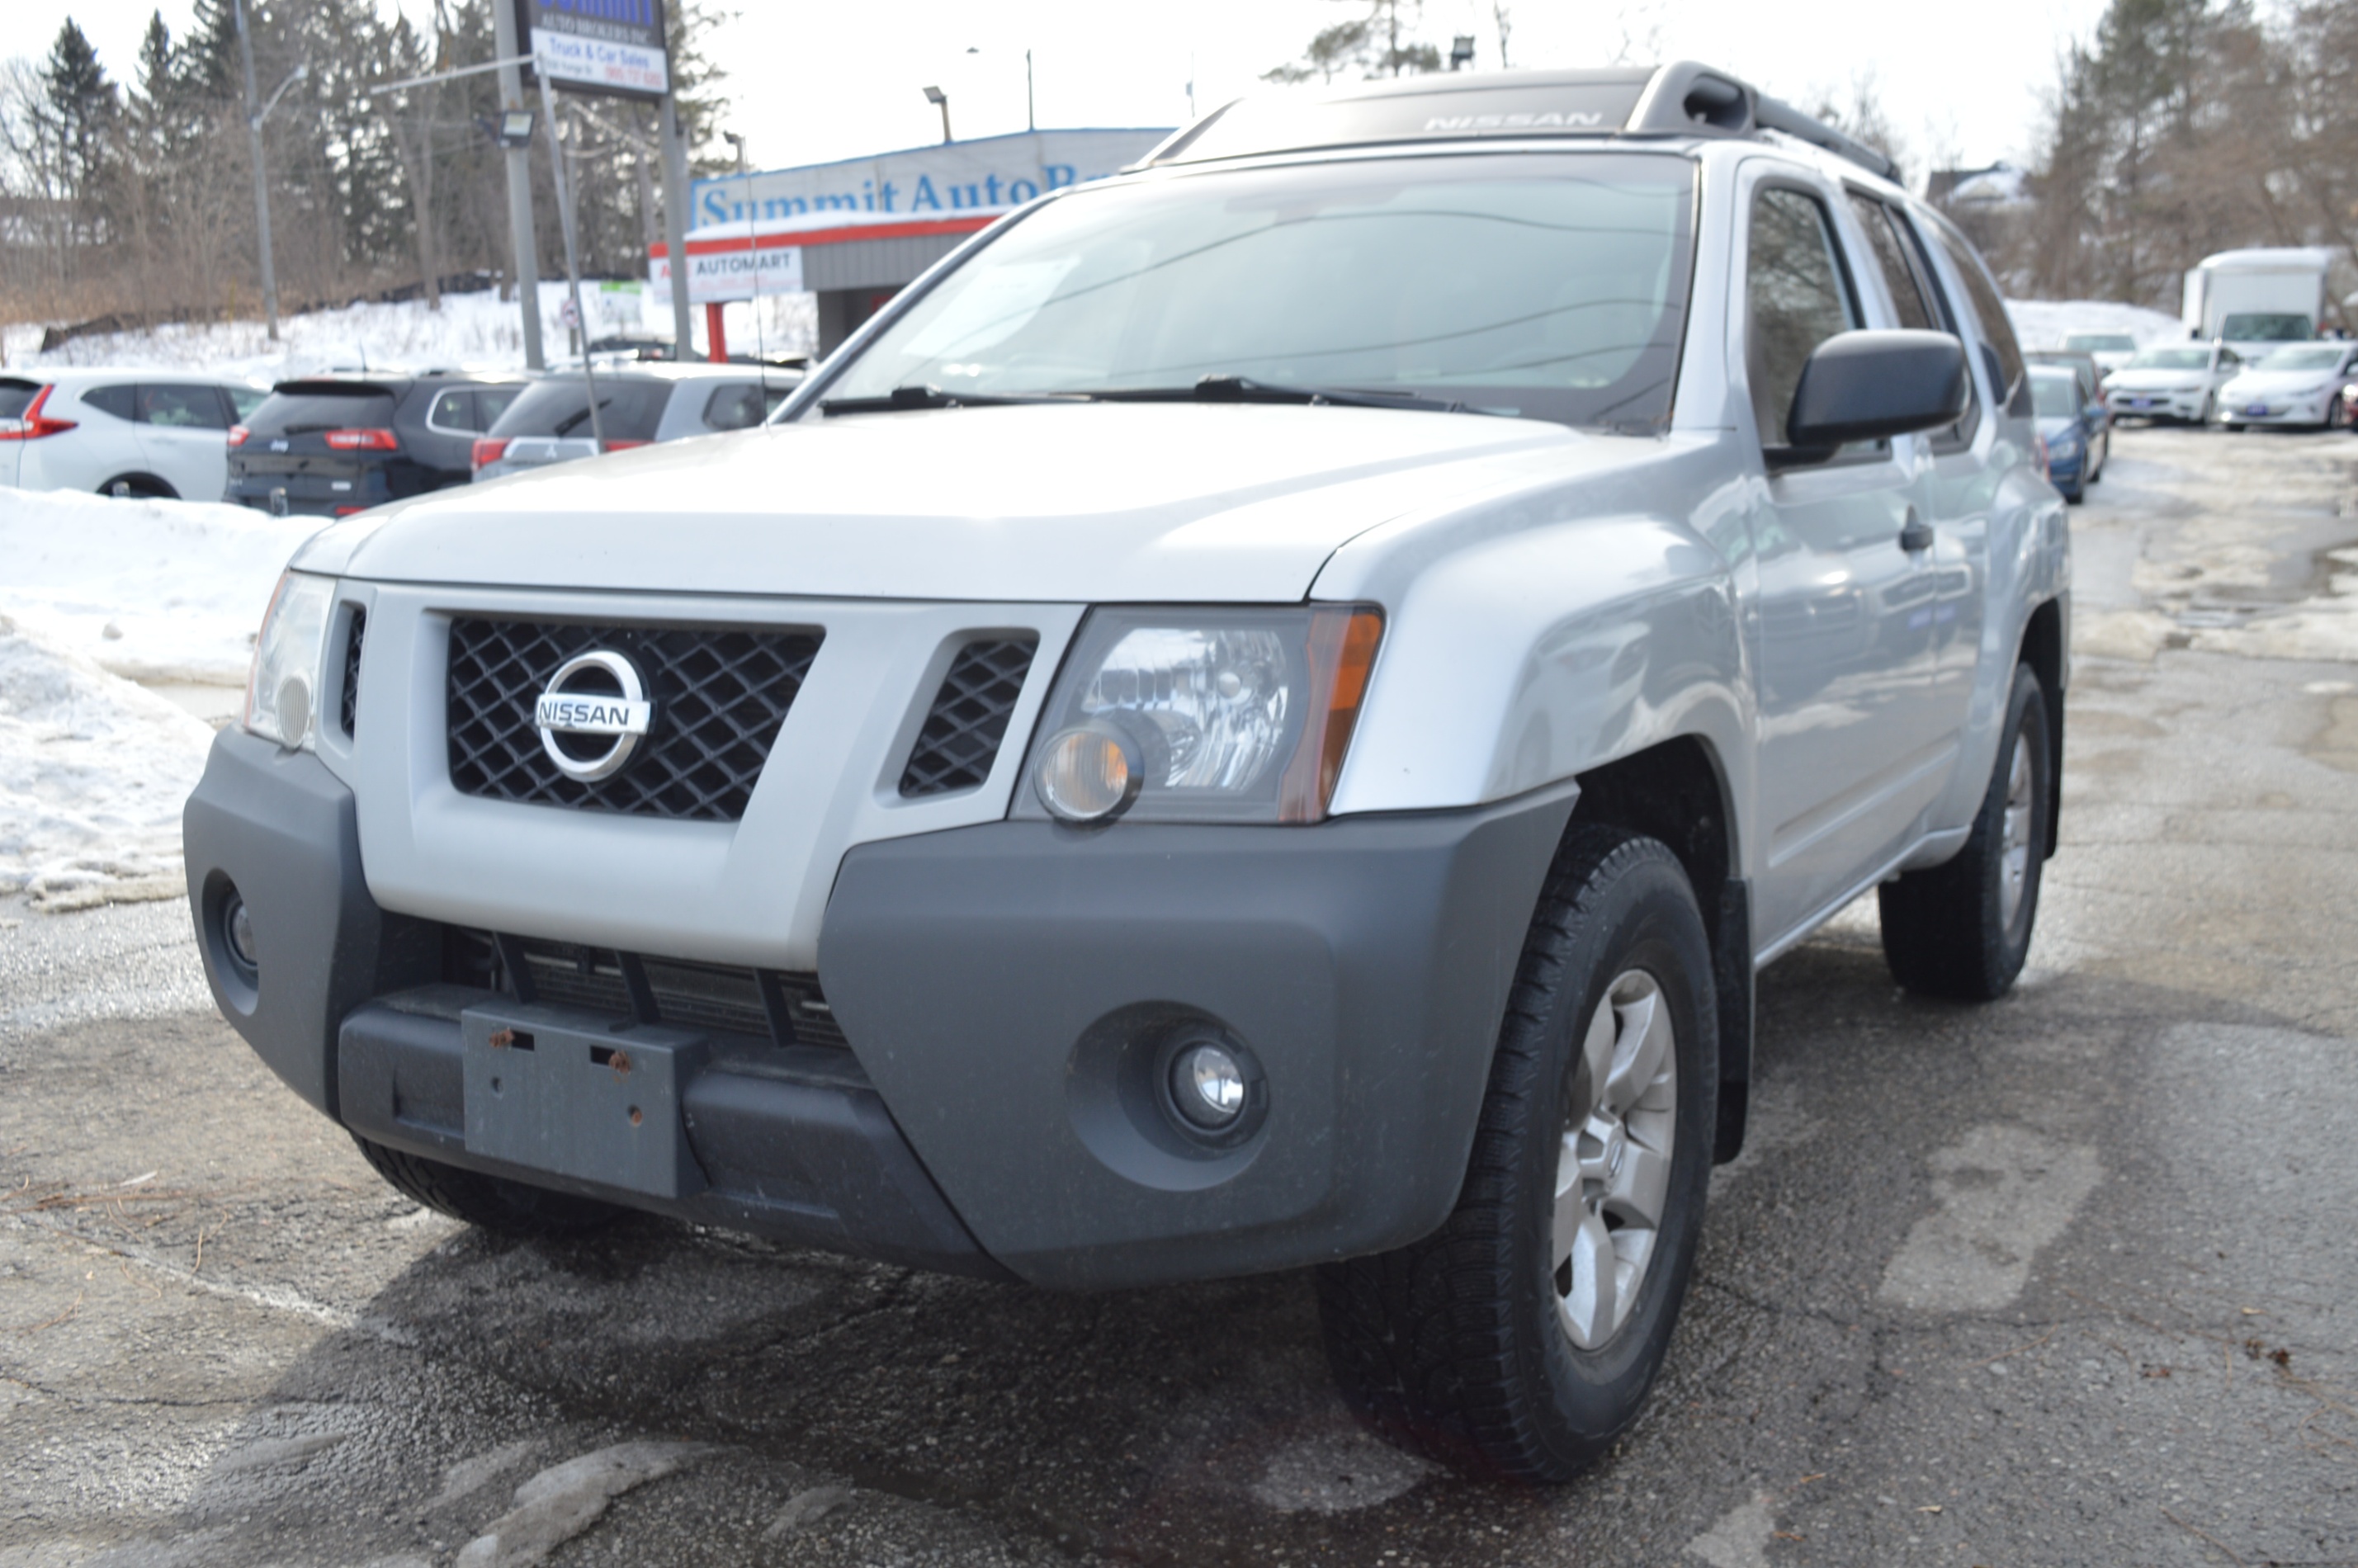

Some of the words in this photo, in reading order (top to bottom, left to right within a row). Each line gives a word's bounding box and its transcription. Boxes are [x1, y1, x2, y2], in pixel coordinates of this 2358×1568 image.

[550, 37, 580, 58] Truck
[587, 43, 594, 59] &
[598, 45, 616, 63] Car
[621, 50, 650, 68] Sales
[1425, 111, 1603, 131] NISSAN
[703, 181, 900, 228] Summit
[696, 253, 791, 276] AUTOMART
[539, 701, 630, 726] NISSAN
